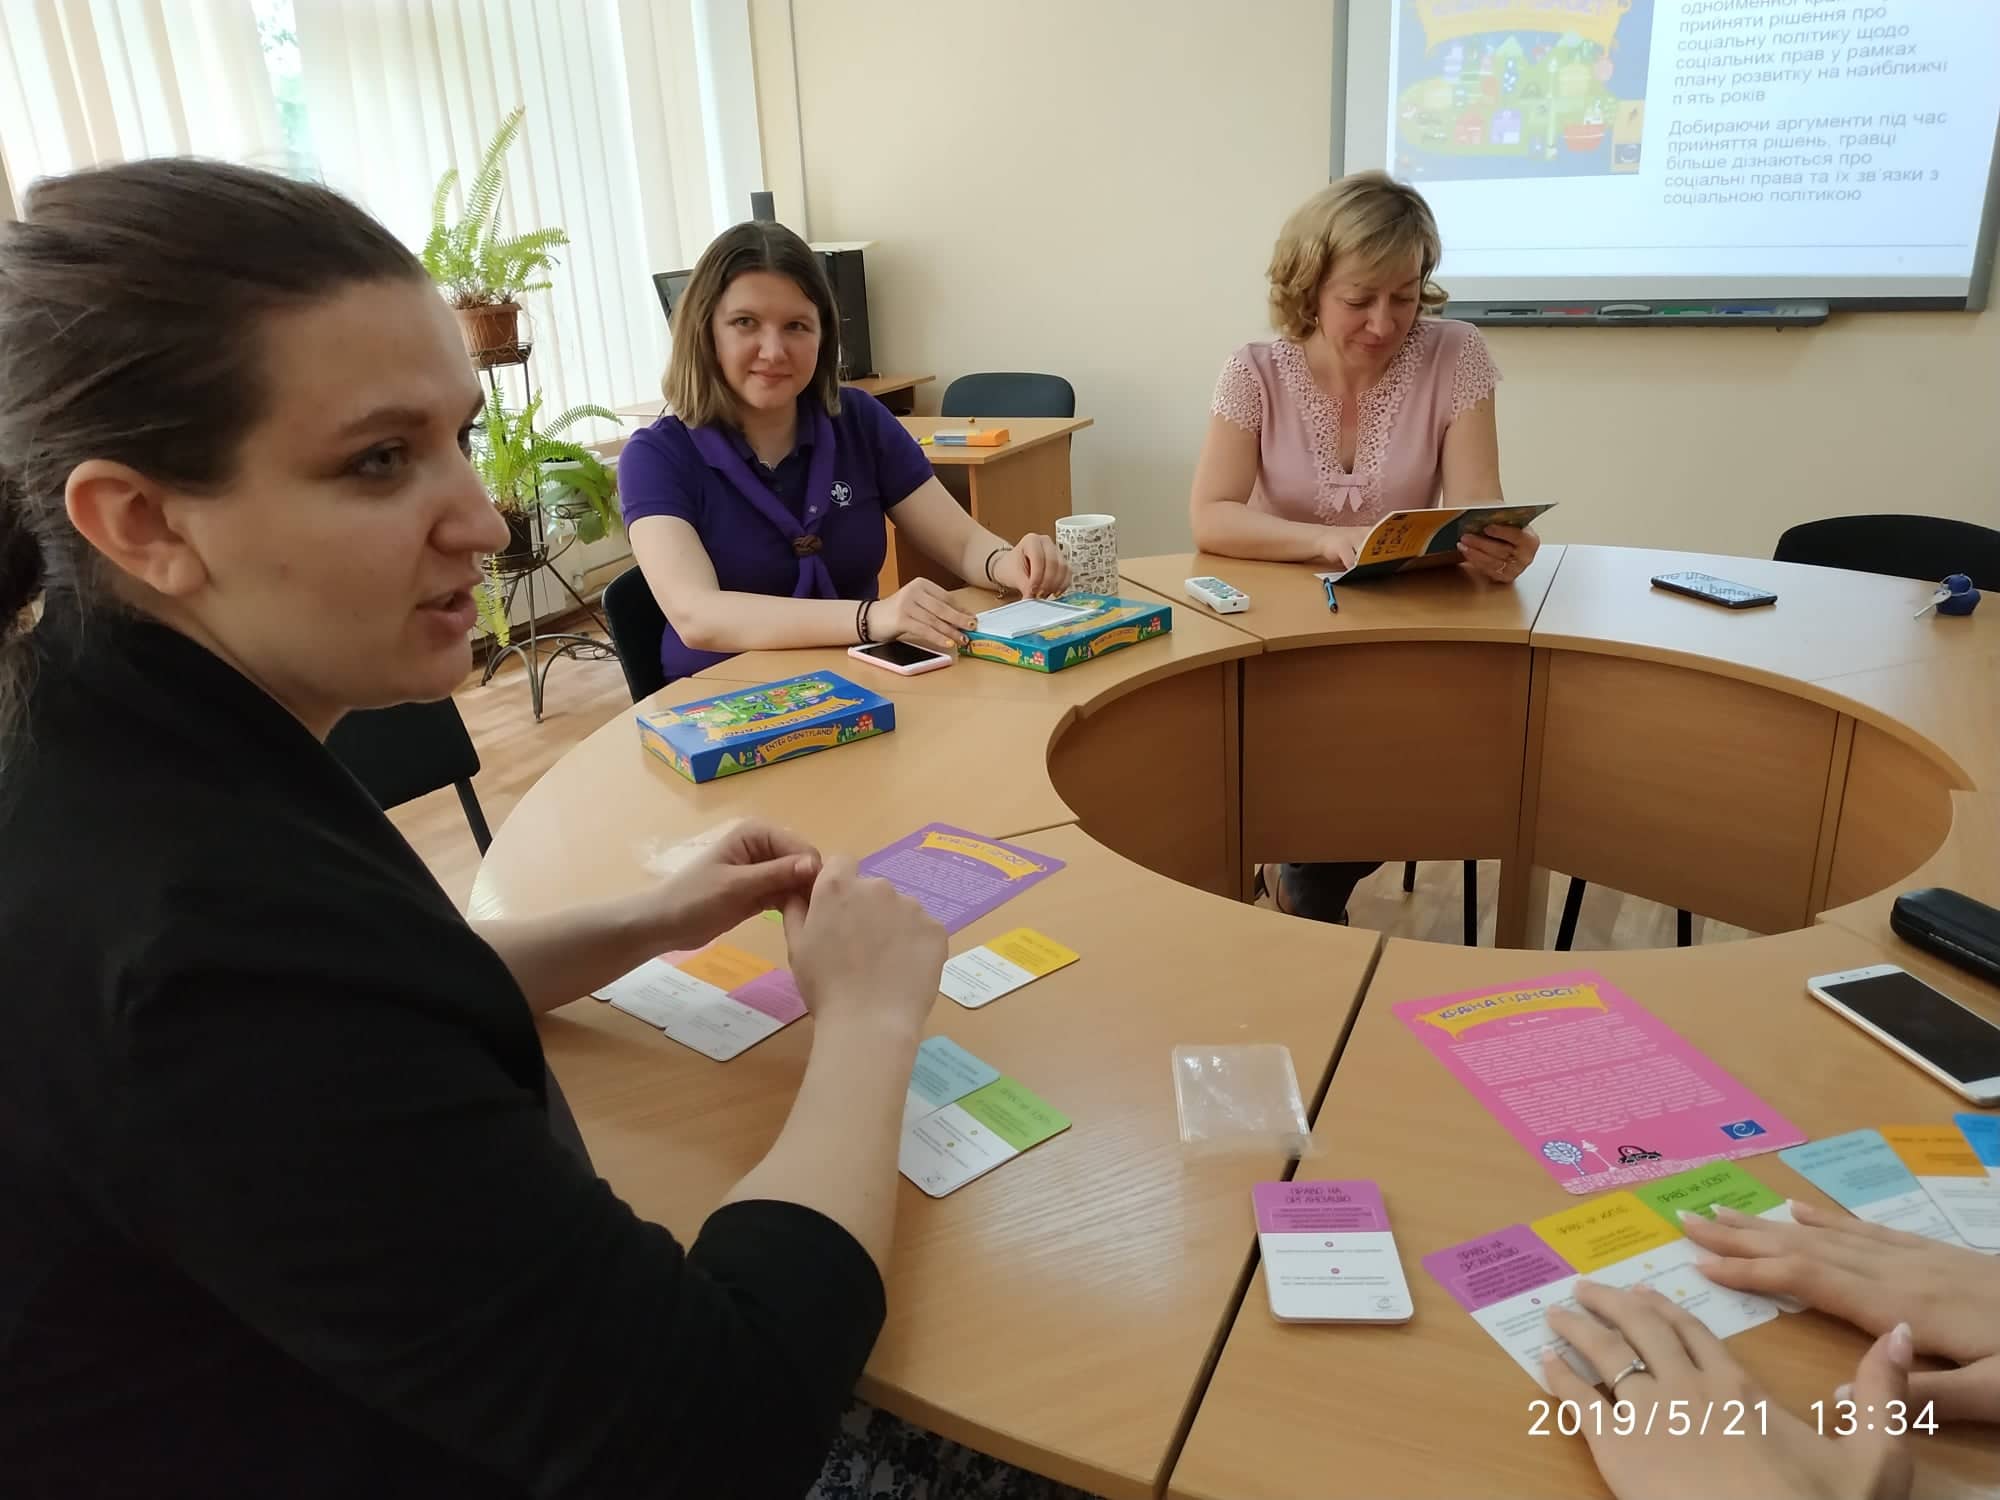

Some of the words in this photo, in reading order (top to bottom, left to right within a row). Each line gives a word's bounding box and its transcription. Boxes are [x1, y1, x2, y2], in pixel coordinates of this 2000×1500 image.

[1679, 15, 1763, 35] прийняти
[1769, 9, 1846, 29] рішення
[1852, 7, 1887, 22] про
[1677, 33, 1766, 52] соціальну
[1772, 28, 1851, 45] політику
[1857, 24, 1910, 40] щодо
[1675, 52, 1775, 71] соціальних
[1781, 49, 1825, 65] прав
[1831, 48, 1842, 63] у
[1846, 43, 1918, 63] рамках
[1674, 72, 1726, 89] плану
[1731, 68, 1812, 88] розвитку
[1817, 66, 1840, 79] на
[1720, 89, 1766, 107] років
[1668, 119, 1770, 136] Добираючи
[1775, 115, 1873, 134] аргументи
[1879, 113, 1907, 128] під
[1913, 111, 1949, 125] час
[1839, 132, 1897, 148] гравці
[1666, 155, 1727, 170] більше
[1731, 153, 1834, 170] дізнаються
[1839, 152, 1873, 168] про
[1665, 174, 1745, 190] соціальні
[1750, 172, 1803, 188] права
[1808, 171, 1830, 185] та
[1928, 169, 1940, 181] з
[1664, 190, 1764, 207] соціальною
[1769, 189, 1862, 202] політикою
[764, 737, 786, 753] ENTER
